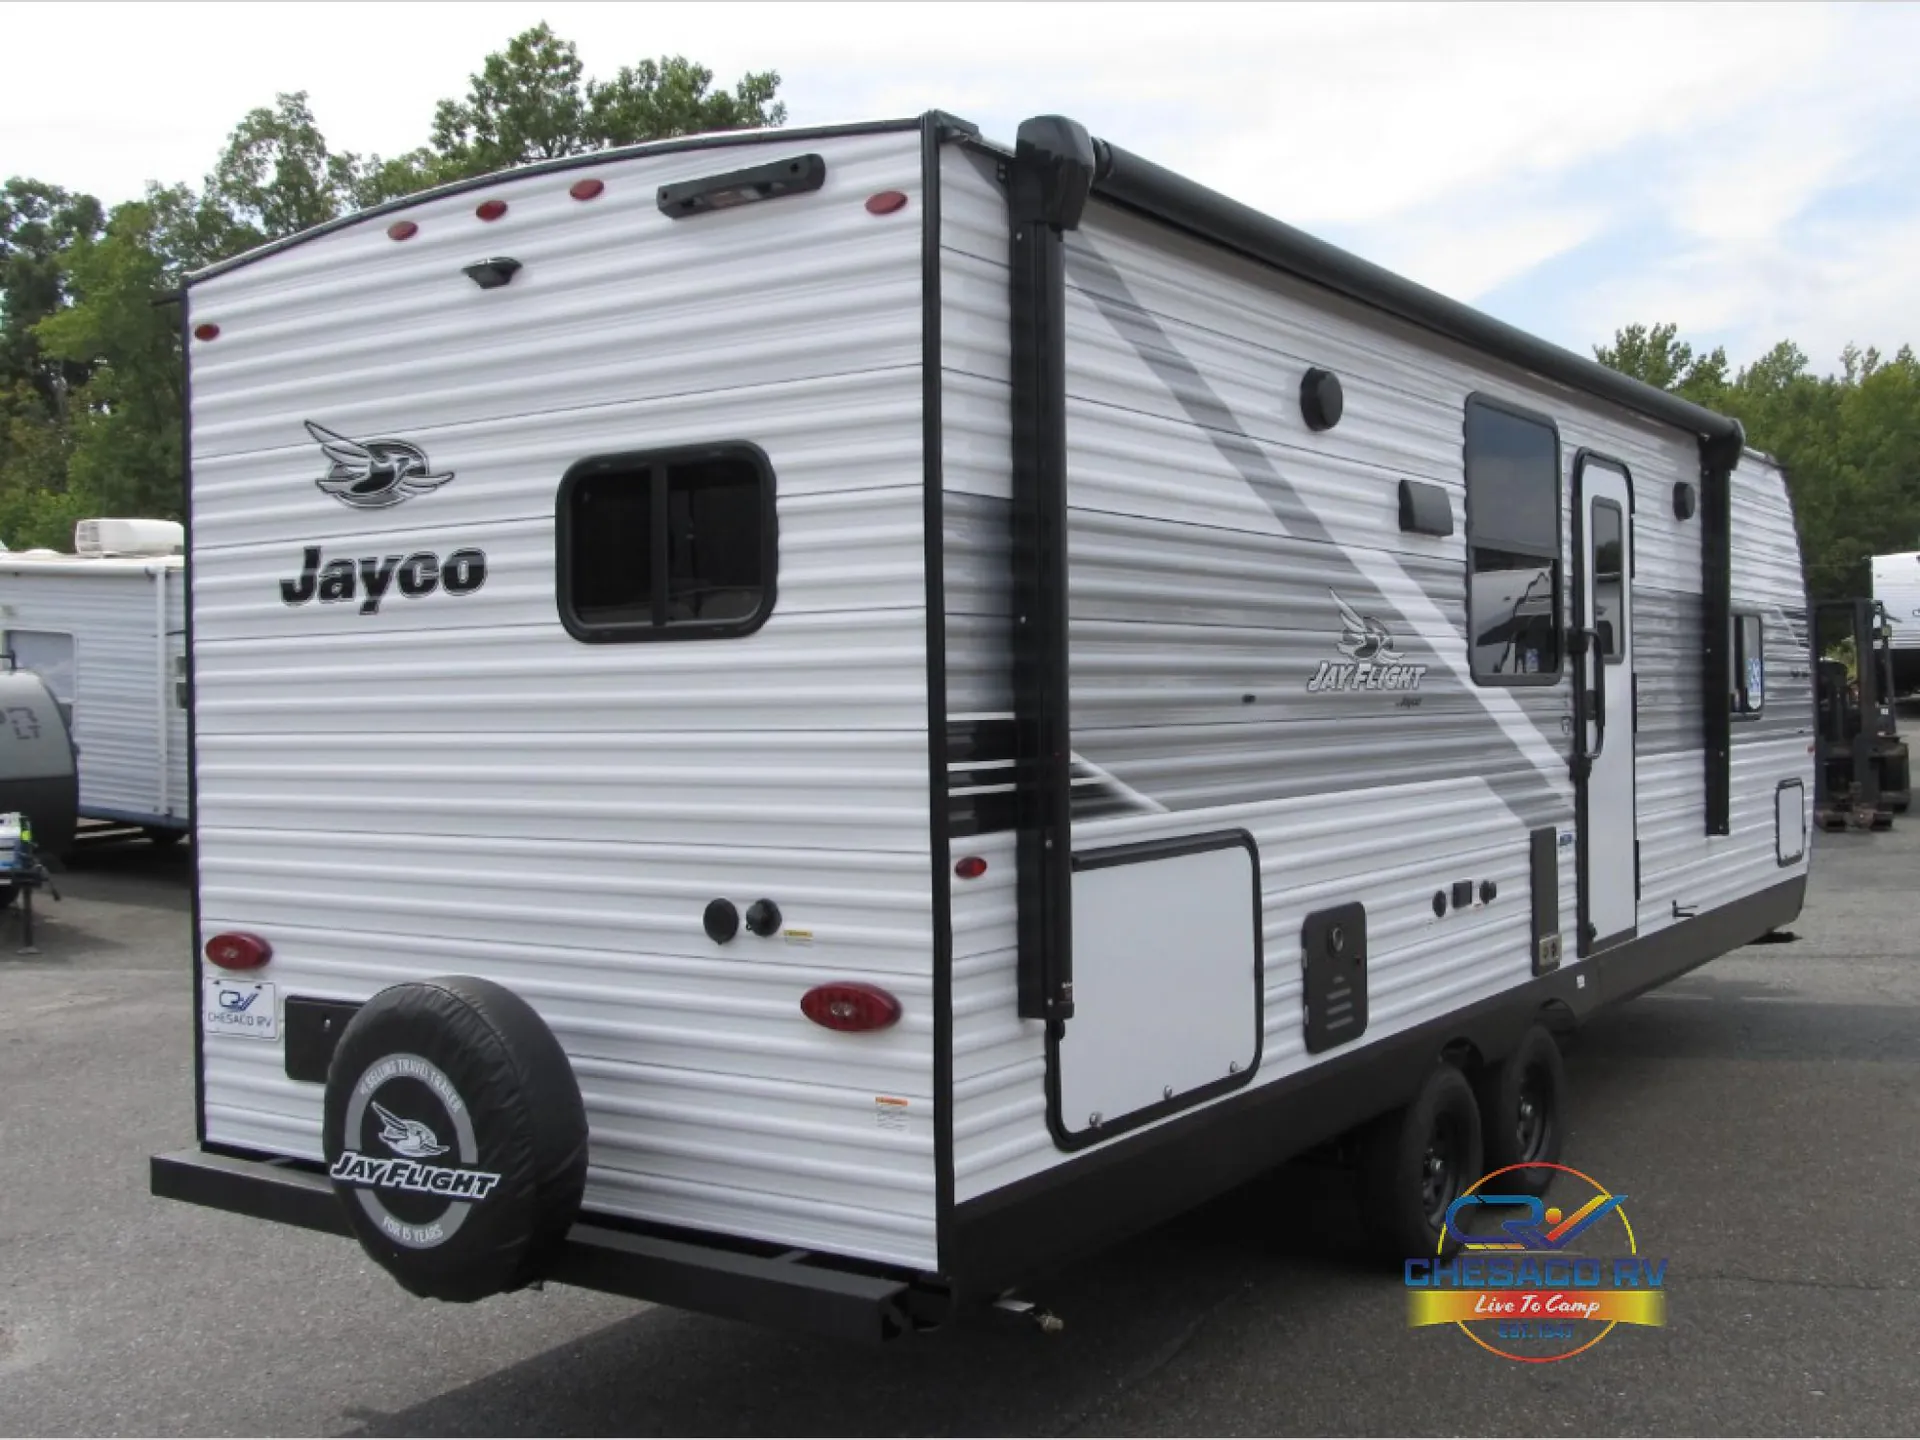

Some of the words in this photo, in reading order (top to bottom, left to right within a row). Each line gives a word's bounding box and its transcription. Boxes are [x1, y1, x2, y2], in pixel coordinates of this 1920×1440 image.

[279, 545, 488, 616] Jayco
[1306, 660, 1354, 692] JAY
[1351, 662, 1427, 691] FLIGHT
[330, 1151, 388, 1184] JAY
[380, 1158, 502, 1199] FLIGHT
